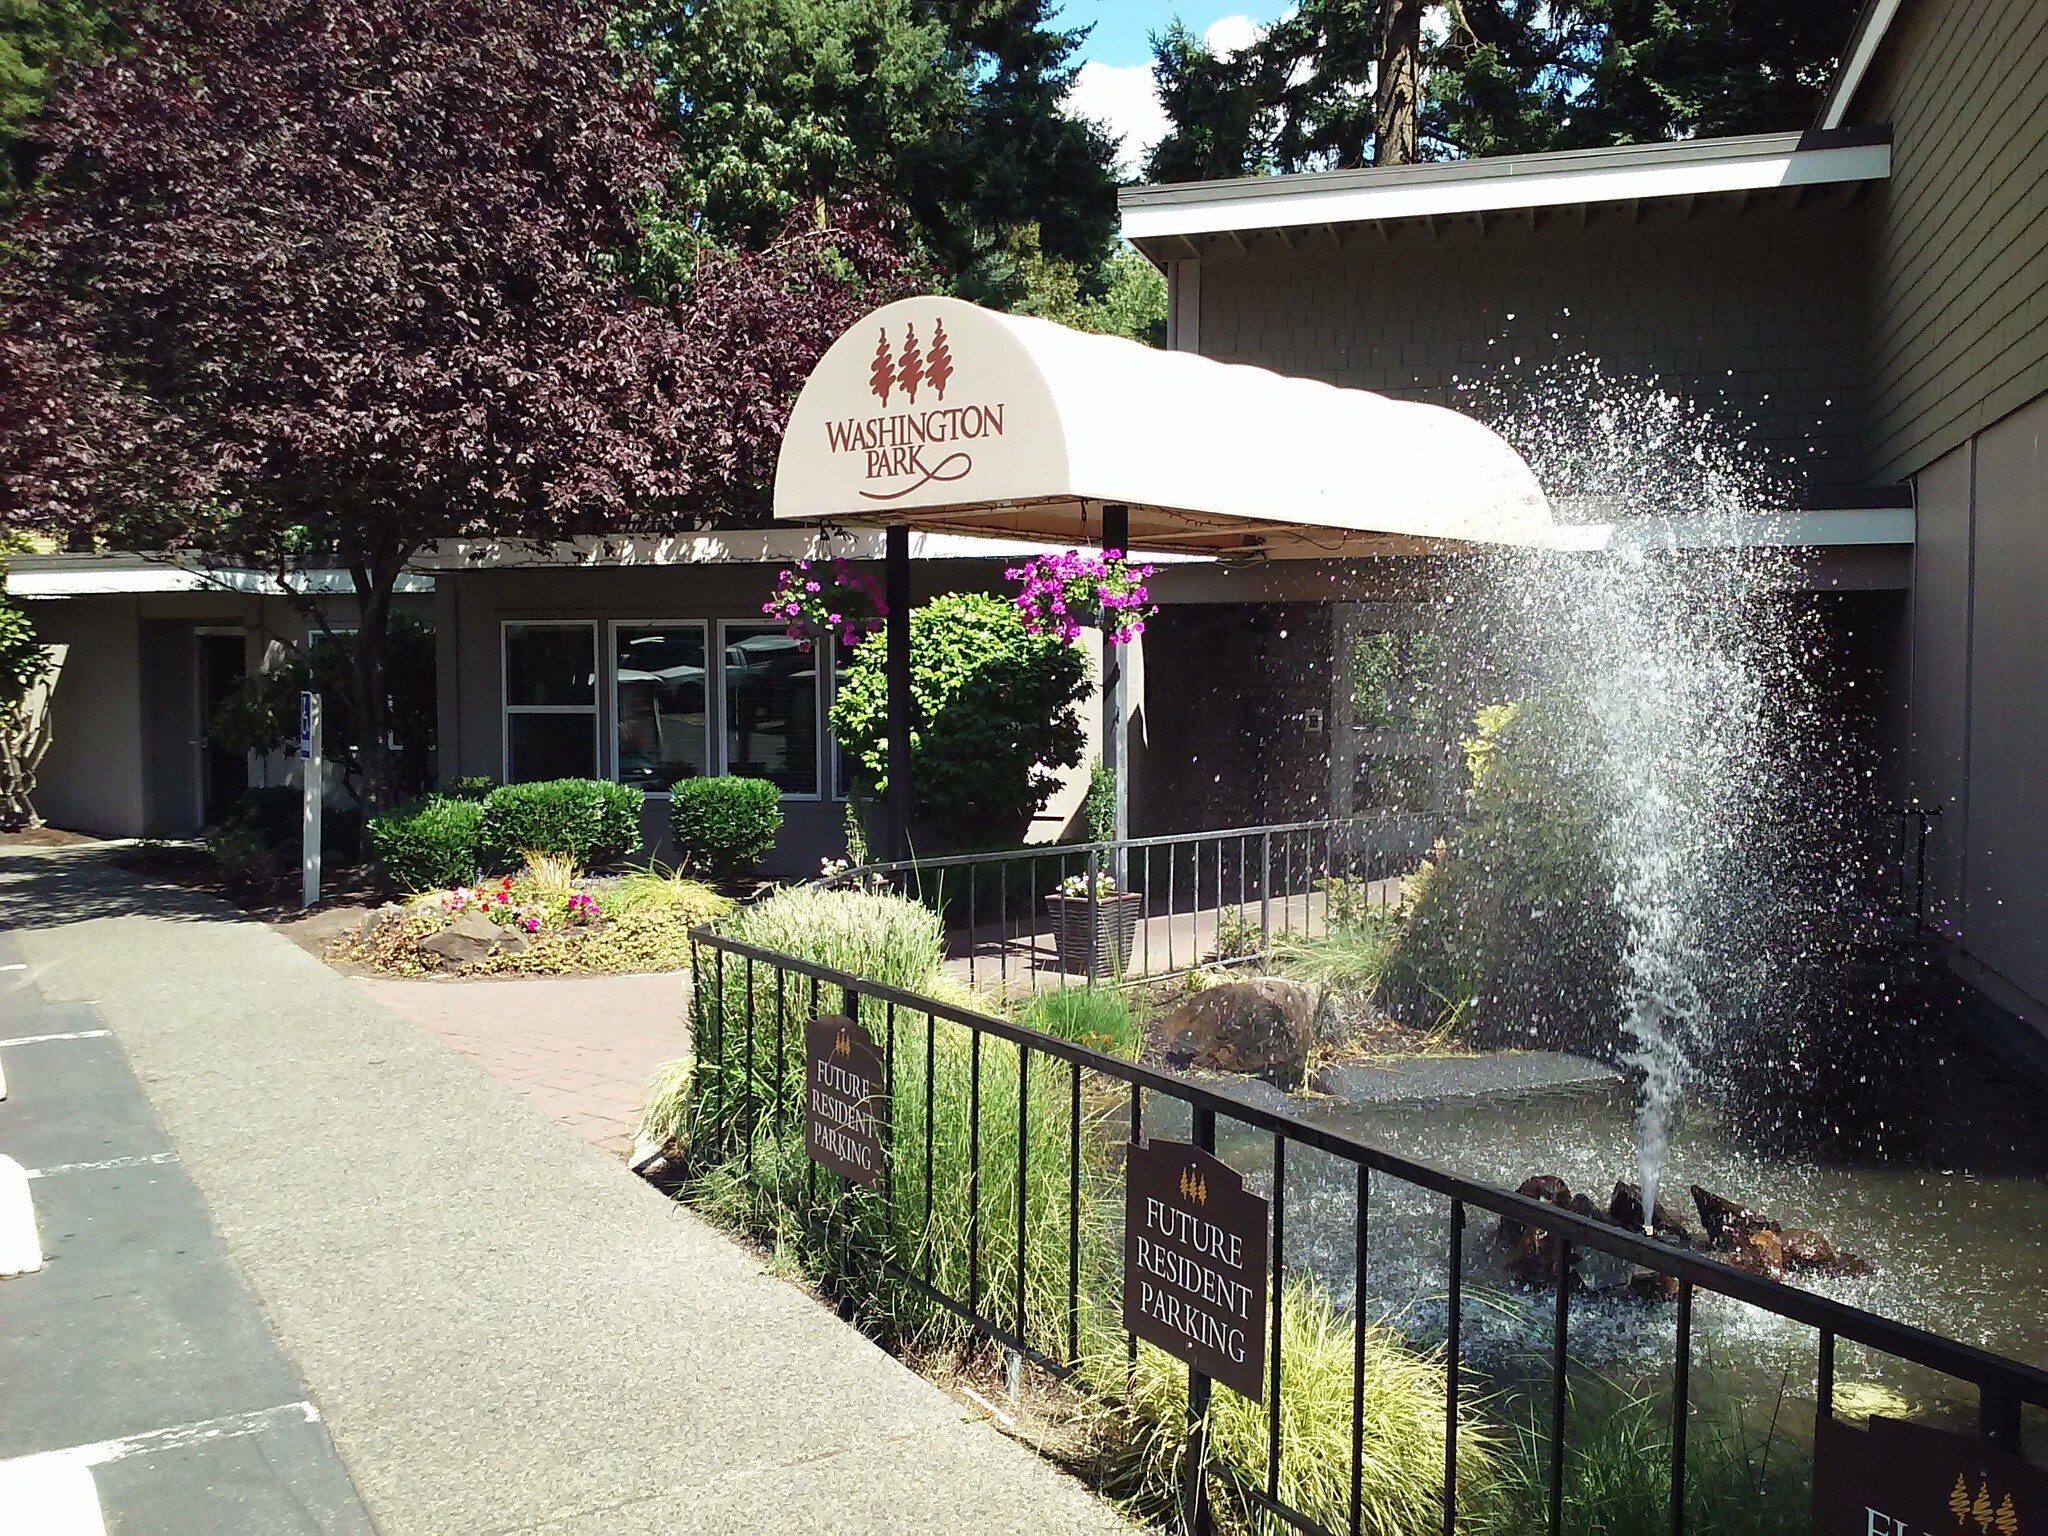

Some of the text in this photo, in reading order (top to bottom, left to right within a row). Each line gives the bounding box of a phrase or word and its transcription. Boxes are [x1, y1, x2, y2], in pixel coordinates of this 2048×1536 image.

[825, 403, 1004, 453] WASHINGTON
[864, 445, 972, 482] PARK
[817, 1059, 870, 1103] FUTURE
[812, 1088, 875, 1139] RESIDENT
[813, 1121, 872, 1171] PARKING
[1146, 1196, 1243, 1270] FUTURE
[1136, 1235, 1253, 1320] RESIDENT
[1140, 1281, 1246, 1364] PARKING
